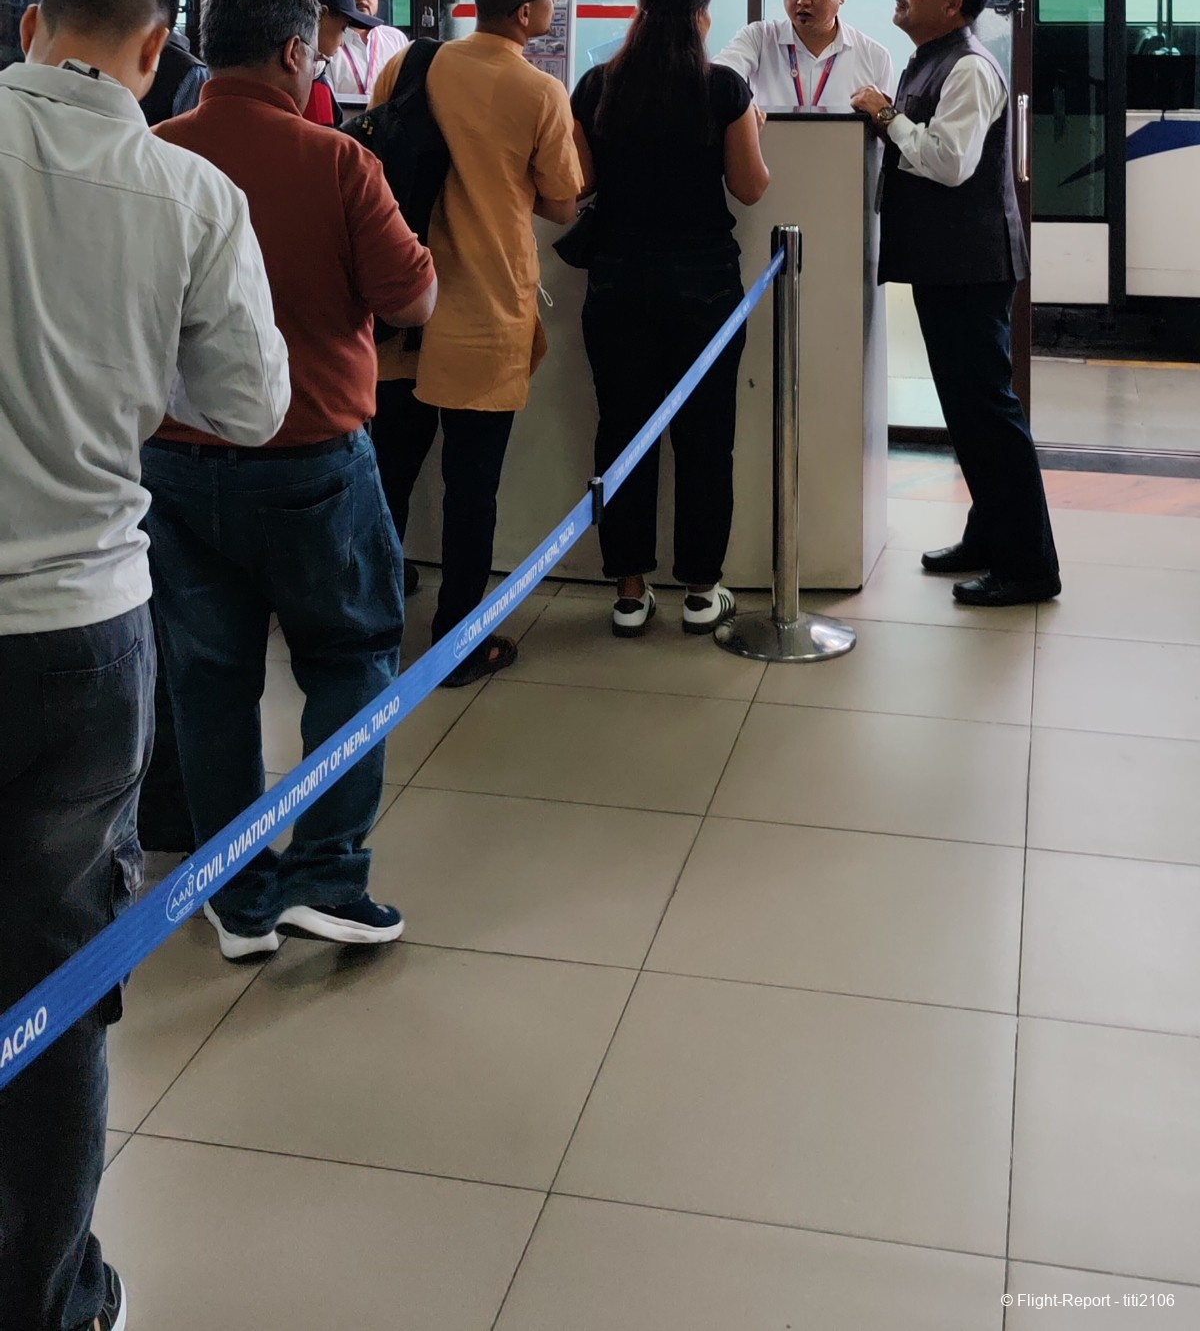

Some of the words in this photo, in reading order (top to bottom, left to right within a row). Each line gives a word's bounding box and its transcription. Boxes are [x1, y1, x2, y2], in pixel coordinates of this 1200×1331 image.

[196, 852, 225, 892] CIVIL
[226, 808, 276, 867] AVIATION
[277, 756, 330, 822] AUTHORITY
[330, 749, 343, 772] OF
[343, 724, 371, 761] NEPAL,
[371, 695, 400, 732] TIACAO
[0, 1005, 48, 1068] ACAO
